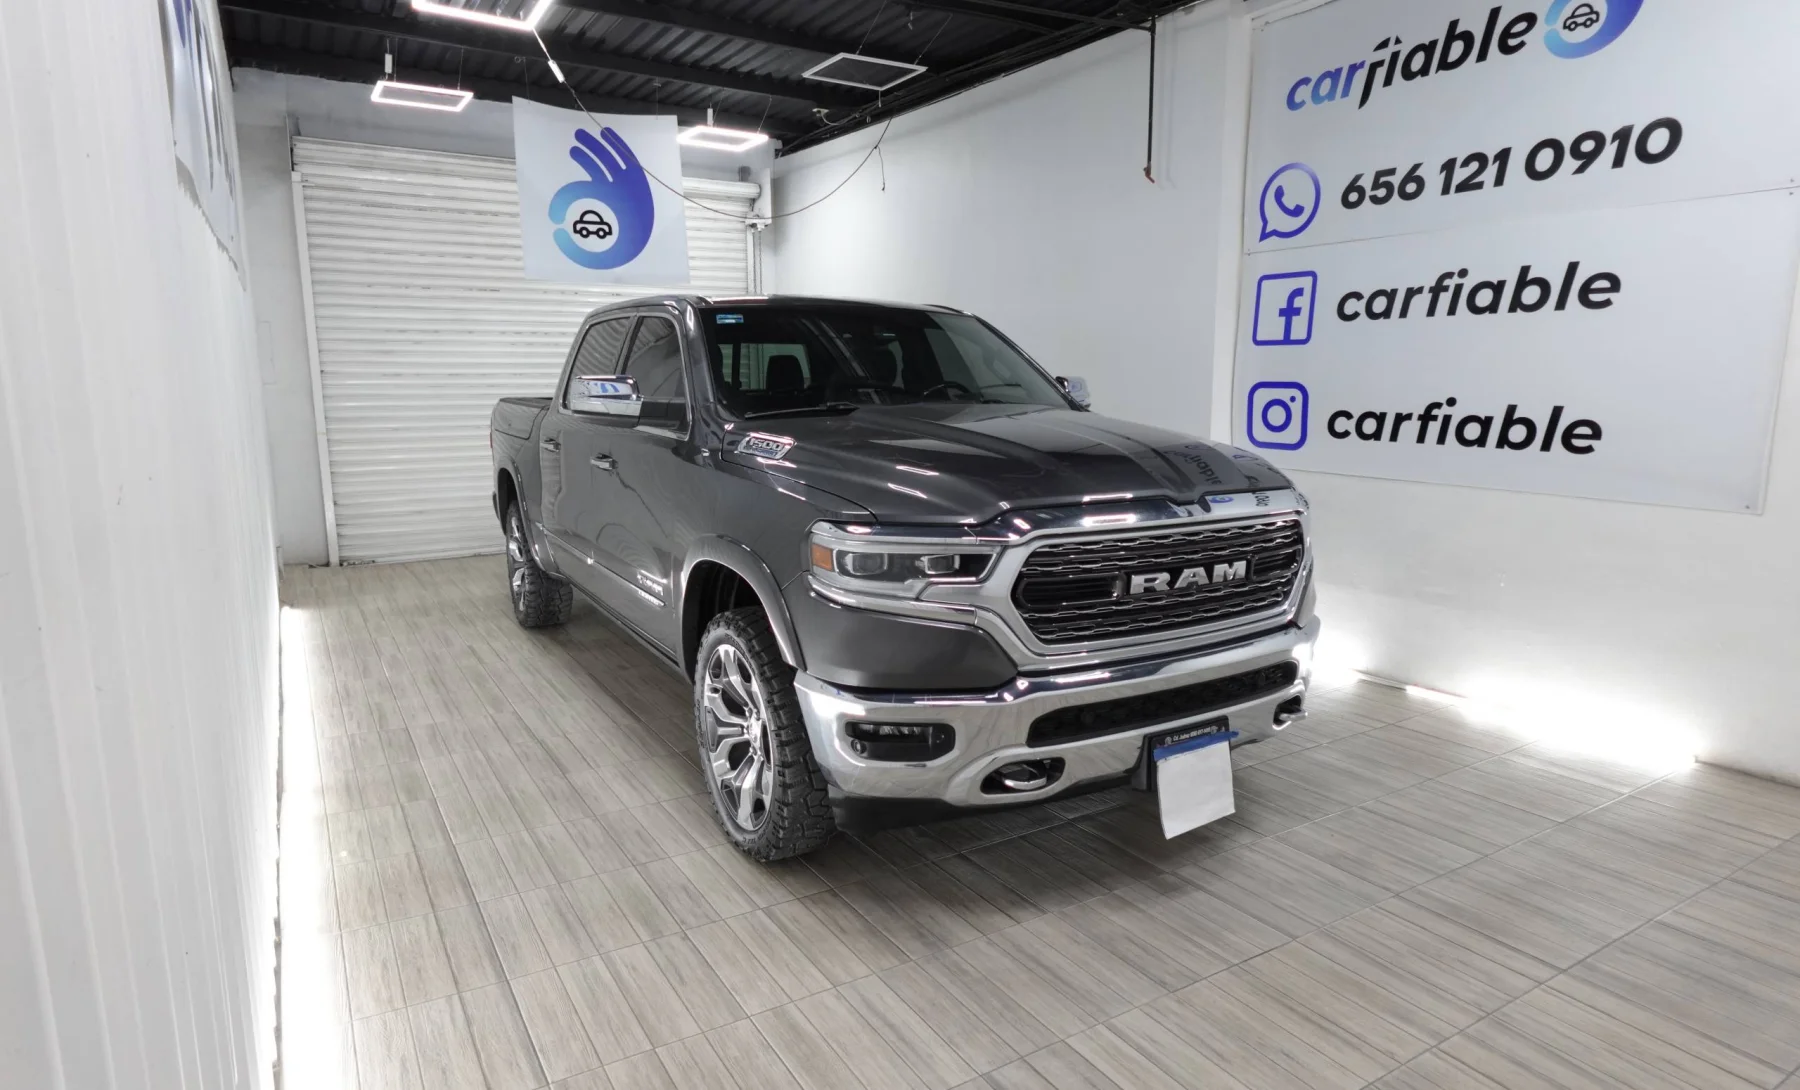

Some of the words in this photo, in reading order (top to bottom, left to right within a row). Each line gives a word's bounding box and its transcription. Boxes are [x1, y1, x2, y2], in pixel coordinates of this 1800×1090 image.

[1286, 5, 1538, 112] carfiable
[1341, 163, 1426, 209] 656
[1440, 147, 1513, 196] 121
[1525, 117, 1683, 182] 0910
[1336, 261, 1622, 323] carfiable
[1327, 396, 1603, 455] carfiable
[1130, 560, 1247, 595] RAM
